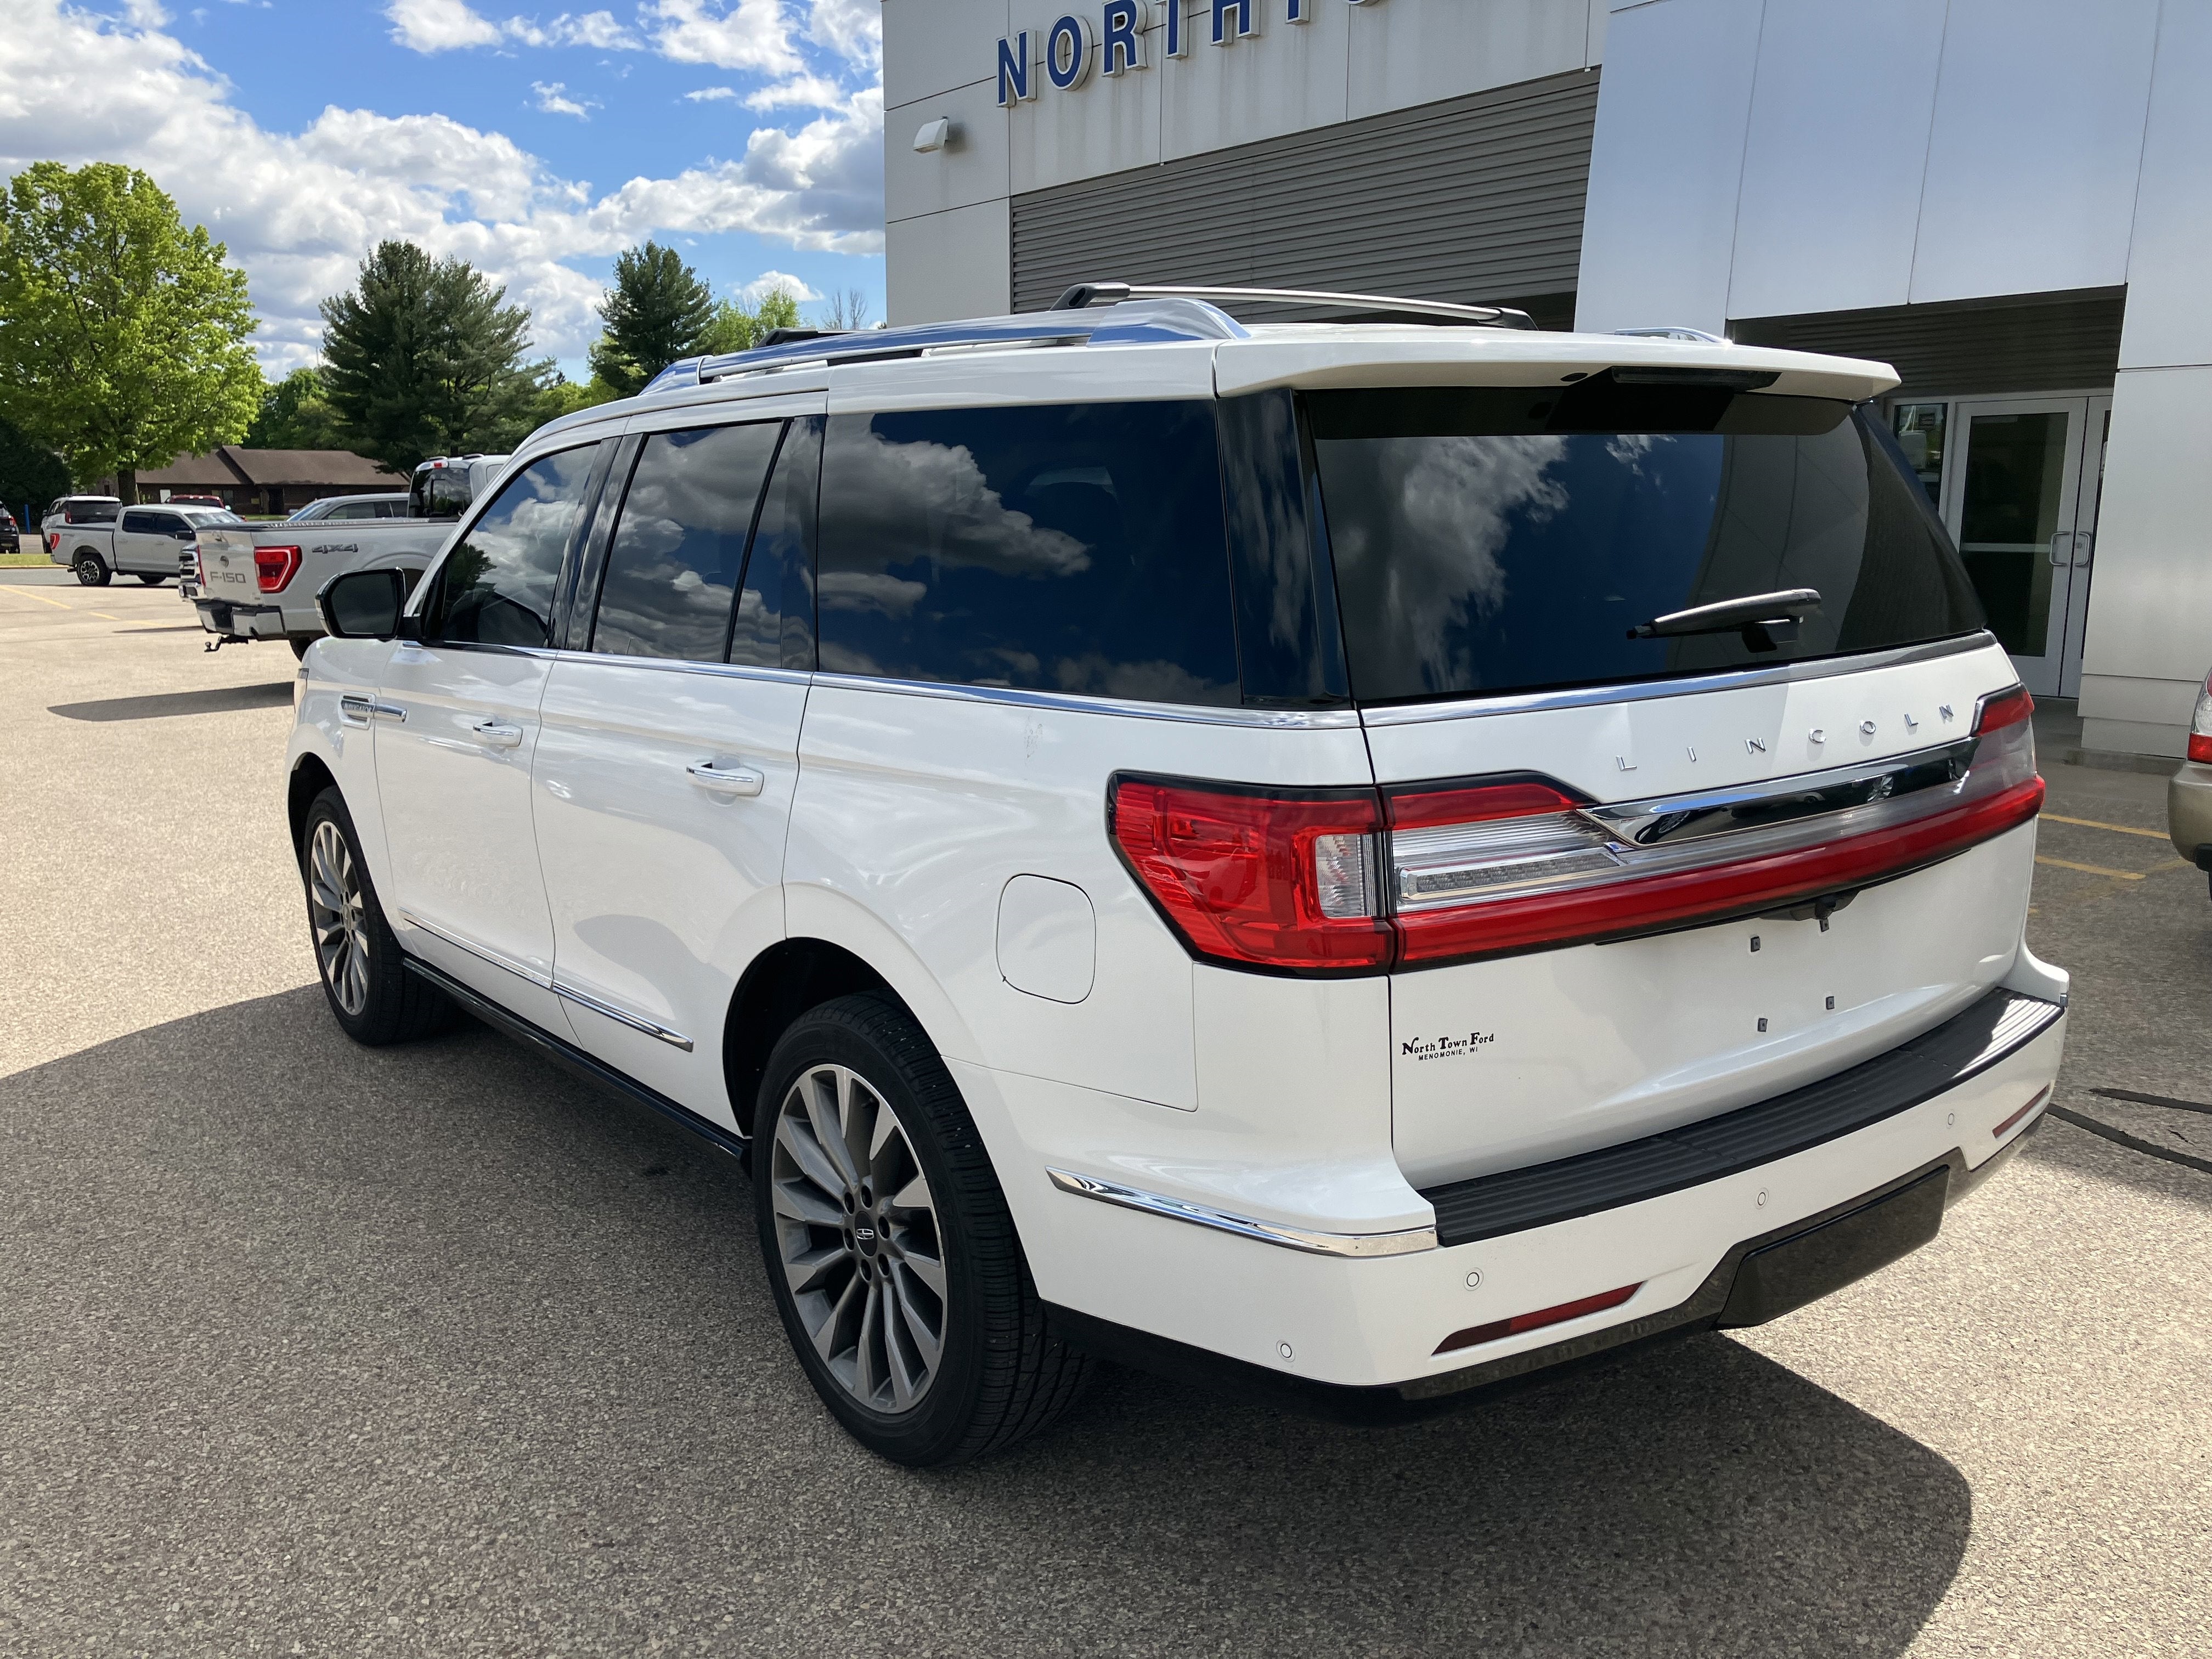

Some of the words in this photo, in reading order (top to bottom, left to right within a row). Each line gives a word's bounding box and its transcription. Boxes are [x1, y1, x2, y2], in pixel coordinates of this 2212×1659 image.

[996, 0, 1378, 108] NORTH
[210, 571, 247, 584] F-150
[1615, 704, 1955, 771] LINCOLN
[1402, 1036, 1436, 1055] North
[1438, 1036, 1467, 1049] Town
[1470, 1031, 1494, 1045] Ford
[1418, 1049, 1465, 1060] MENOMONIE,
